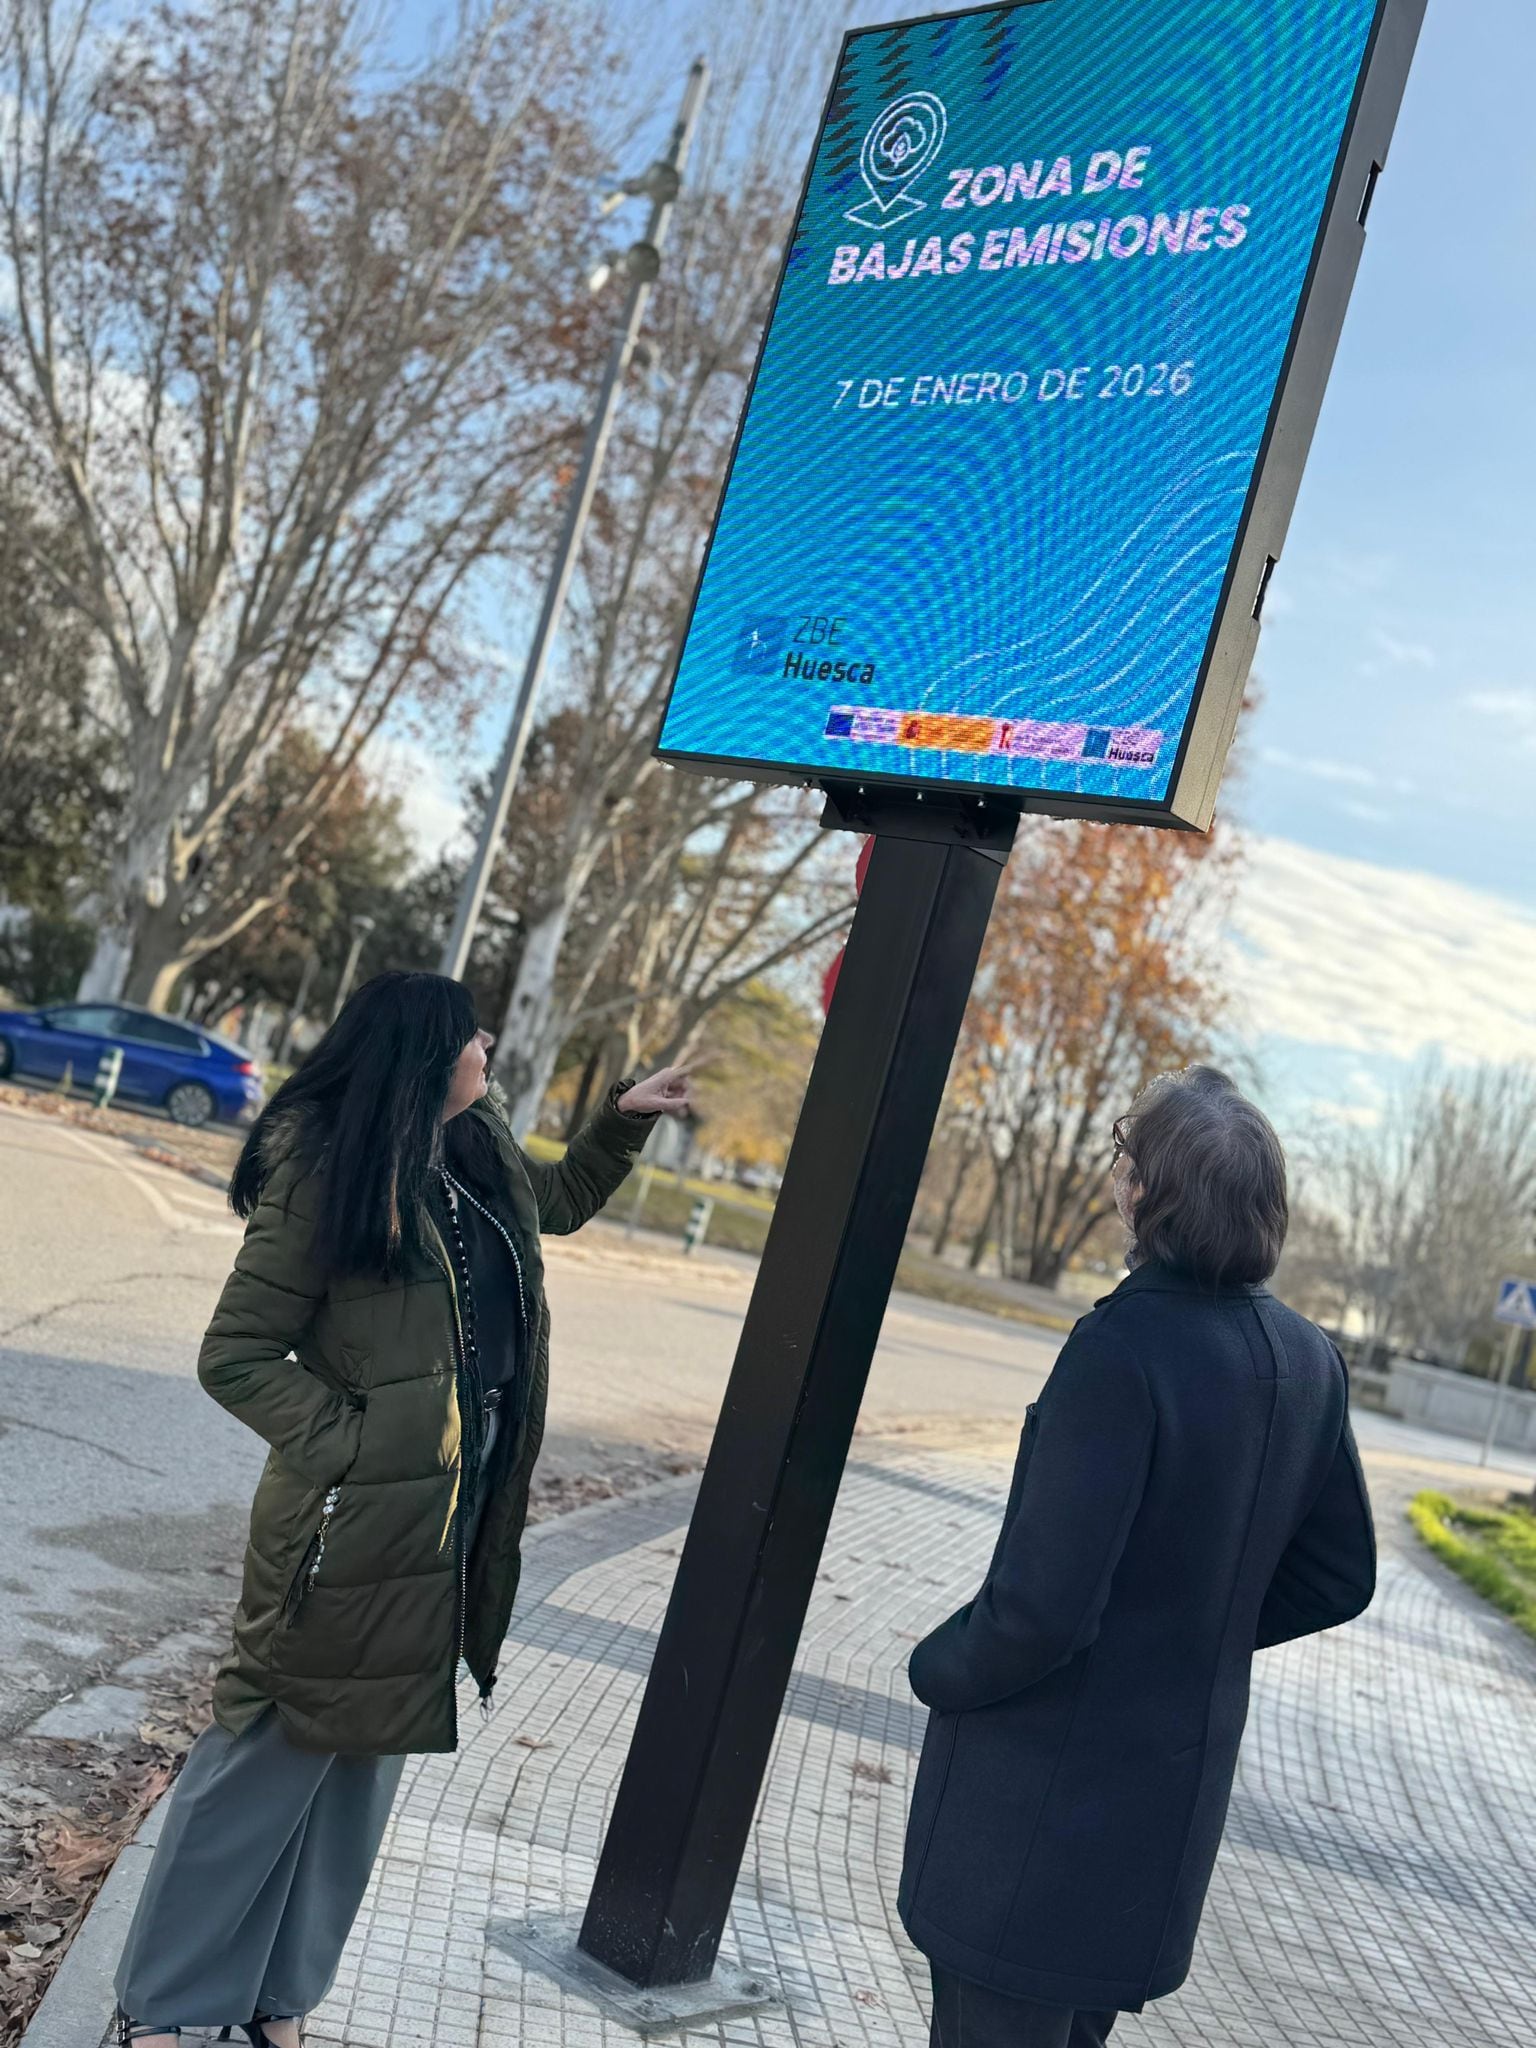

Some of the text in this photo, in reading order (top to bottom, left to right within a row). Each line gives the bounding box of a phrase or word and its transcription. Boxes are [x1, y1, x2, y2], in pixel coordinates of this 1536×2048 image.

[941, 146, 1152, 210] ZONA DE
[828, 204, 1251, 285] BAJAS EMISIONES
[832, 360, 1196, 409] 7 DE ENERO DE 2026
[792, 615, 847, 646] ZBE
[782, 651, 876, 685] Huesca
